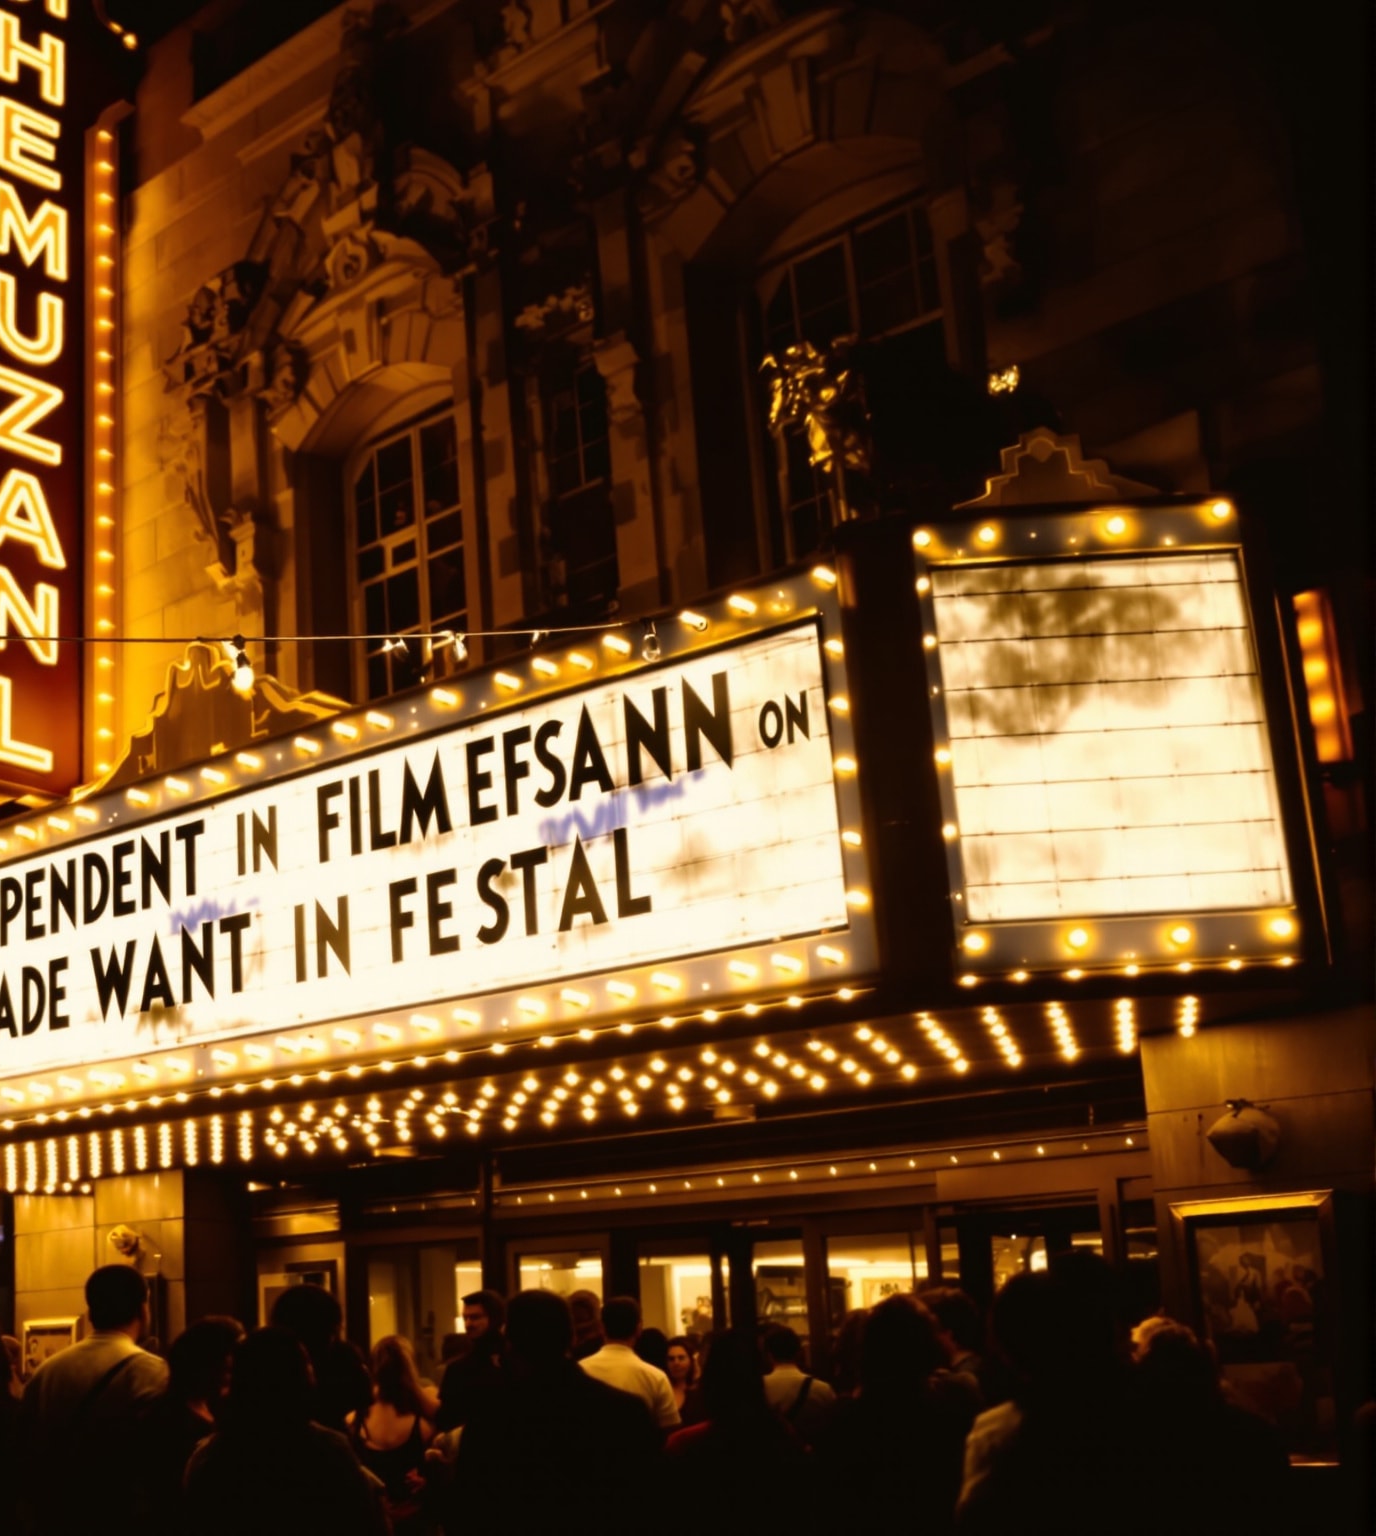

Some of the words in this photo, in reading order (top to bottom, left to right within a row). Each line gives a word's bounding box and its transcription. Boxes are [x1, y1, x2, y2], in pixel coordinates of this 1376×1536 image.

[237, 804, 278, 876] IN
[759, 690, 810, 749] ON
[90, 913, 251, 1022] WANT
[294, 895, 351, 983] IN
